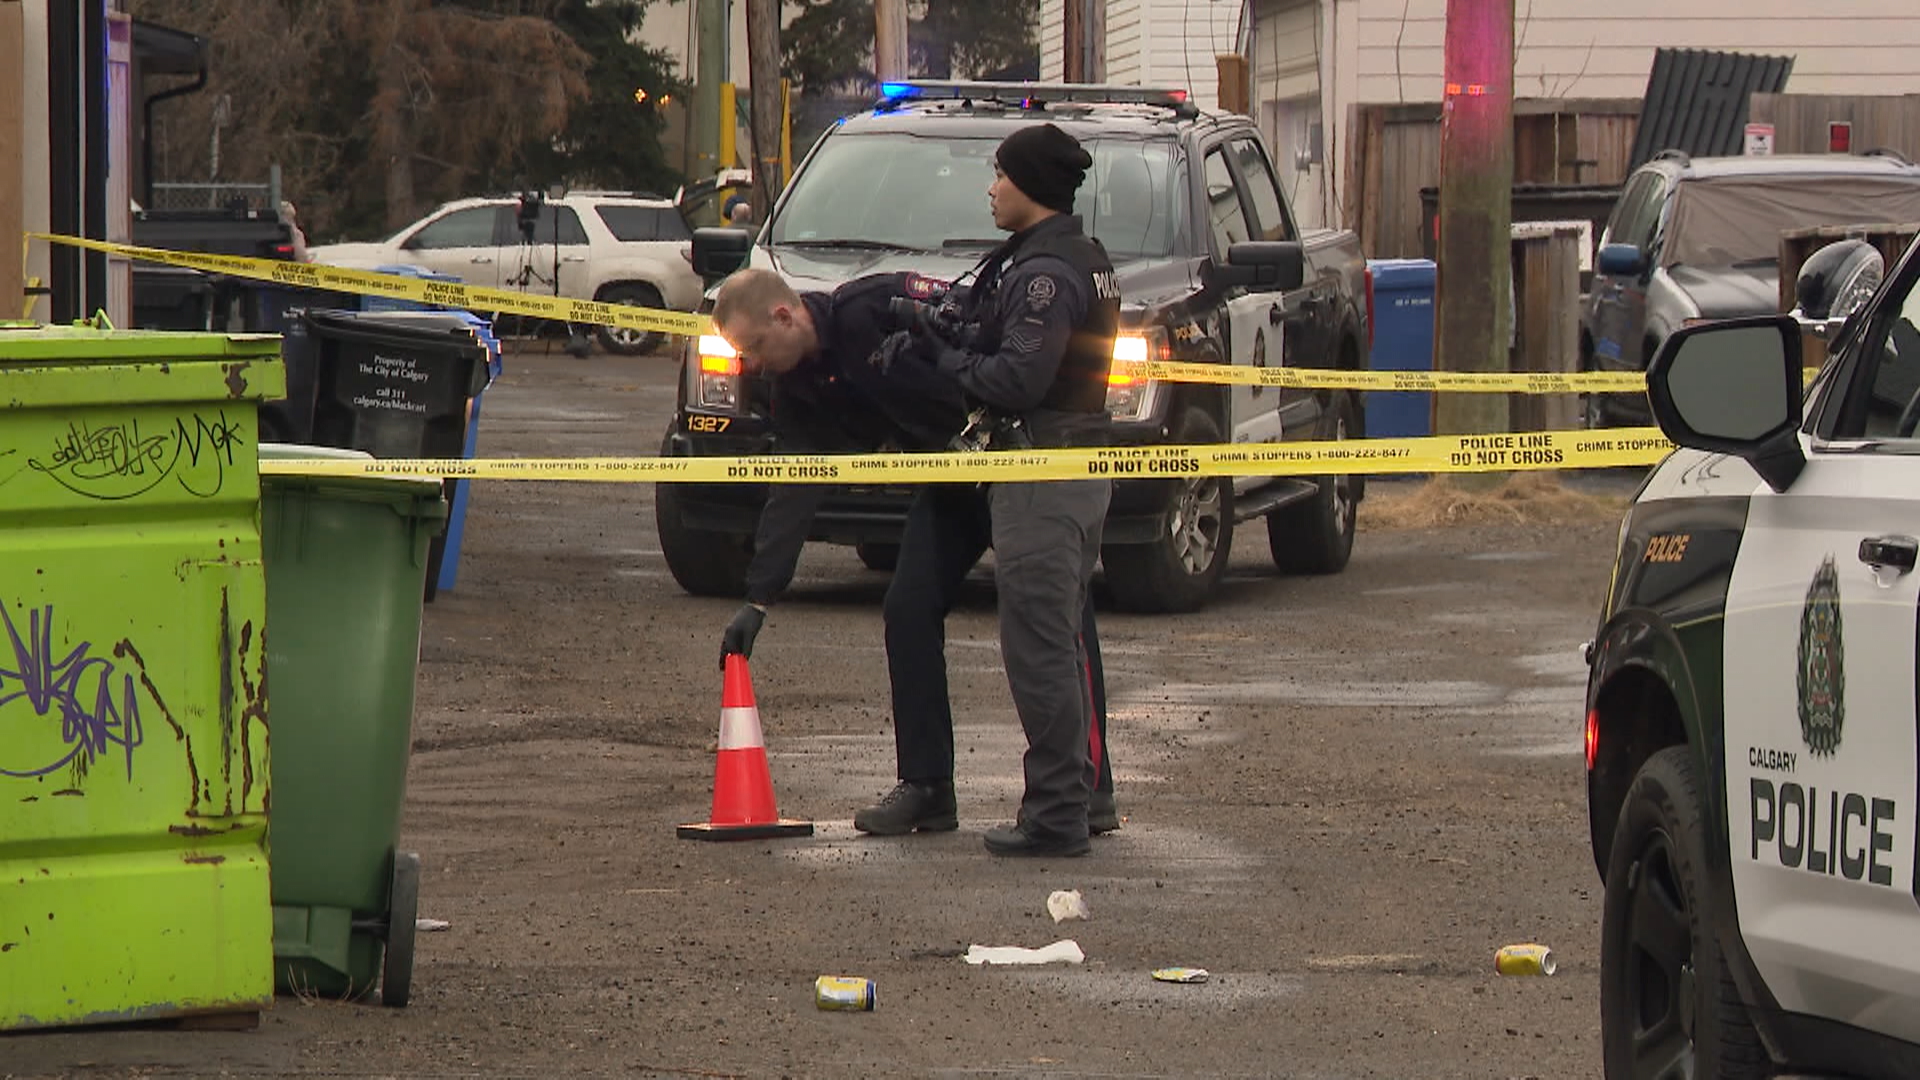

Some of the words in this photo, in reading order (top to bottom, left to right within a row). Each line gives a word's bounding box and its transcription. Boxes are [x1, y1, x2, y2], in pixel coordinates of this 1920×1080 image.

[276, 263, 301, 273] POLICE
[300, 265, 318, 276] LINE
[426, 282, 450, 294] POLICE
[450, 284, 465, 296] LINE
[423, 292, 433, 301] DO
[433, 293, 448, 303] NOT
[572, 301, 595, 311] POLICE
[595, 302, 611, 314] LINE
[570, 311, 579, 320] DO
[580, 312, 593, 322] NOT
[374, 355, 406, 369] Property
[407, 358, 417, 368] of
[359, 363, 373, 375] The
[374, 365, 390, 379] City
[390, 367, 400, 377] of
[401, 369, 429, 383] Calgary
[376, 387, 392, 398] call
[391, 388, 406, 400] 311
[687, 414, 732, 433] 1327
[1459, 436, 1515, 450] POLICE
[1519, 434, 1553, 448] LINE
[1576, 440, 1614, 453] CRIME
[1212, 450, 1249, 463] CRIME
[1252, 449, 1313, 461] STOPPERS
[1316, 448, 1411, 460] 1-800-222-8477
[1451, 451, 1471, 467] DO
[1476, 450, 1506, 466] NOT
[1512, 448, 1564, 465] CROSS
[364, 464, 385, 473] DO
[530, 462, 590, 471] STOPPERS
[851, 460, 889, 470] CRIME
[892, 458, 951, 469] STOPPERS
[955, 457, 1049, 468] 1-800-222-8477
[1088, 460, 1109, 474] DO
[1114, 459, 1144, 473] NOT
[1149, 457, 1200, 473] CROSS
[727, 465, 748, 478] DO
[753, 465, 783, 478] NOT
[788, 464, 839, 479] CROSS
[1642, 534, 1691, 563] POLICE
[1749, 747, 1797, 774] CALGARY
[1750, 777, 1896, 887] POLICE
